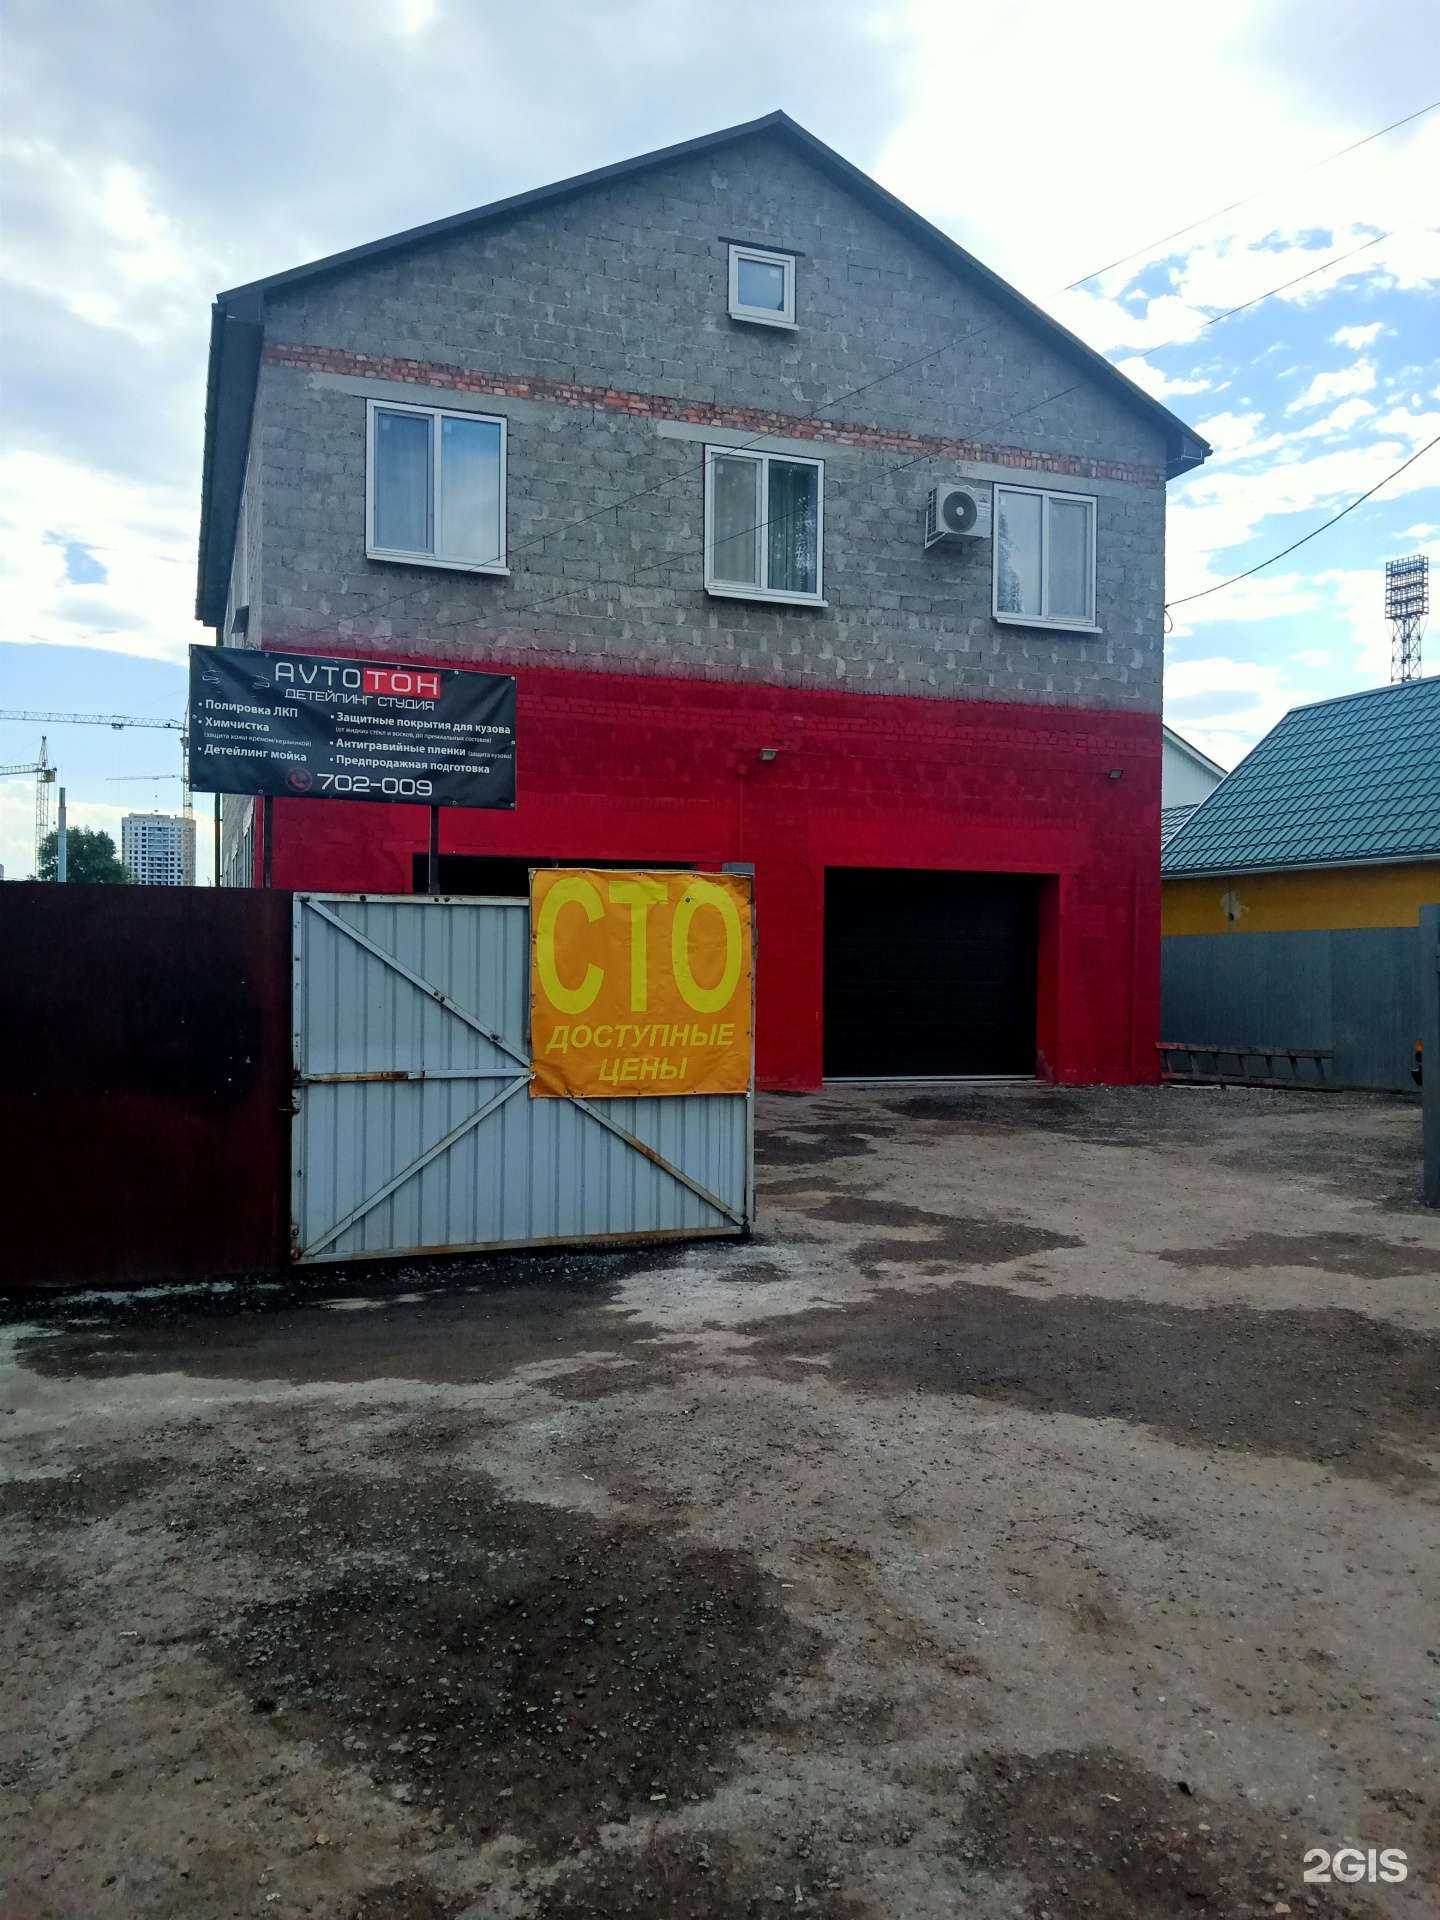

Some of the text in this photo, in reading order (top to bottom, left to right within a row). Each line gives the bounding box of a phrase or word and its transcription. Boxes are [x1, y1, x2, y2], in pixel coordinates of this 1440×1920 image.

[205, 699, 298, 718] Полировка ЛКП
[378, 697, 434, 711] СТУДИЯ
[205, 717, 270, 732] Химчистка
[336, 712, 511, 735] Защитные покрытия для кузова
[204, 744, 307, 762] Детейлинг мойка
[336, 738, 425, 753] Антигравийные
[428, 745, 466, 756] пленки
[336, 755, 490, 774] Предпродажная подготовка
[317, 773, 433, 796] 702-009
[536, 876, 743, 1015] СТО
[545, 1023, 736, 1054] ДОСТУПНЫЕ
[598, 1056, 688, 1086] ЦЕНЫ
